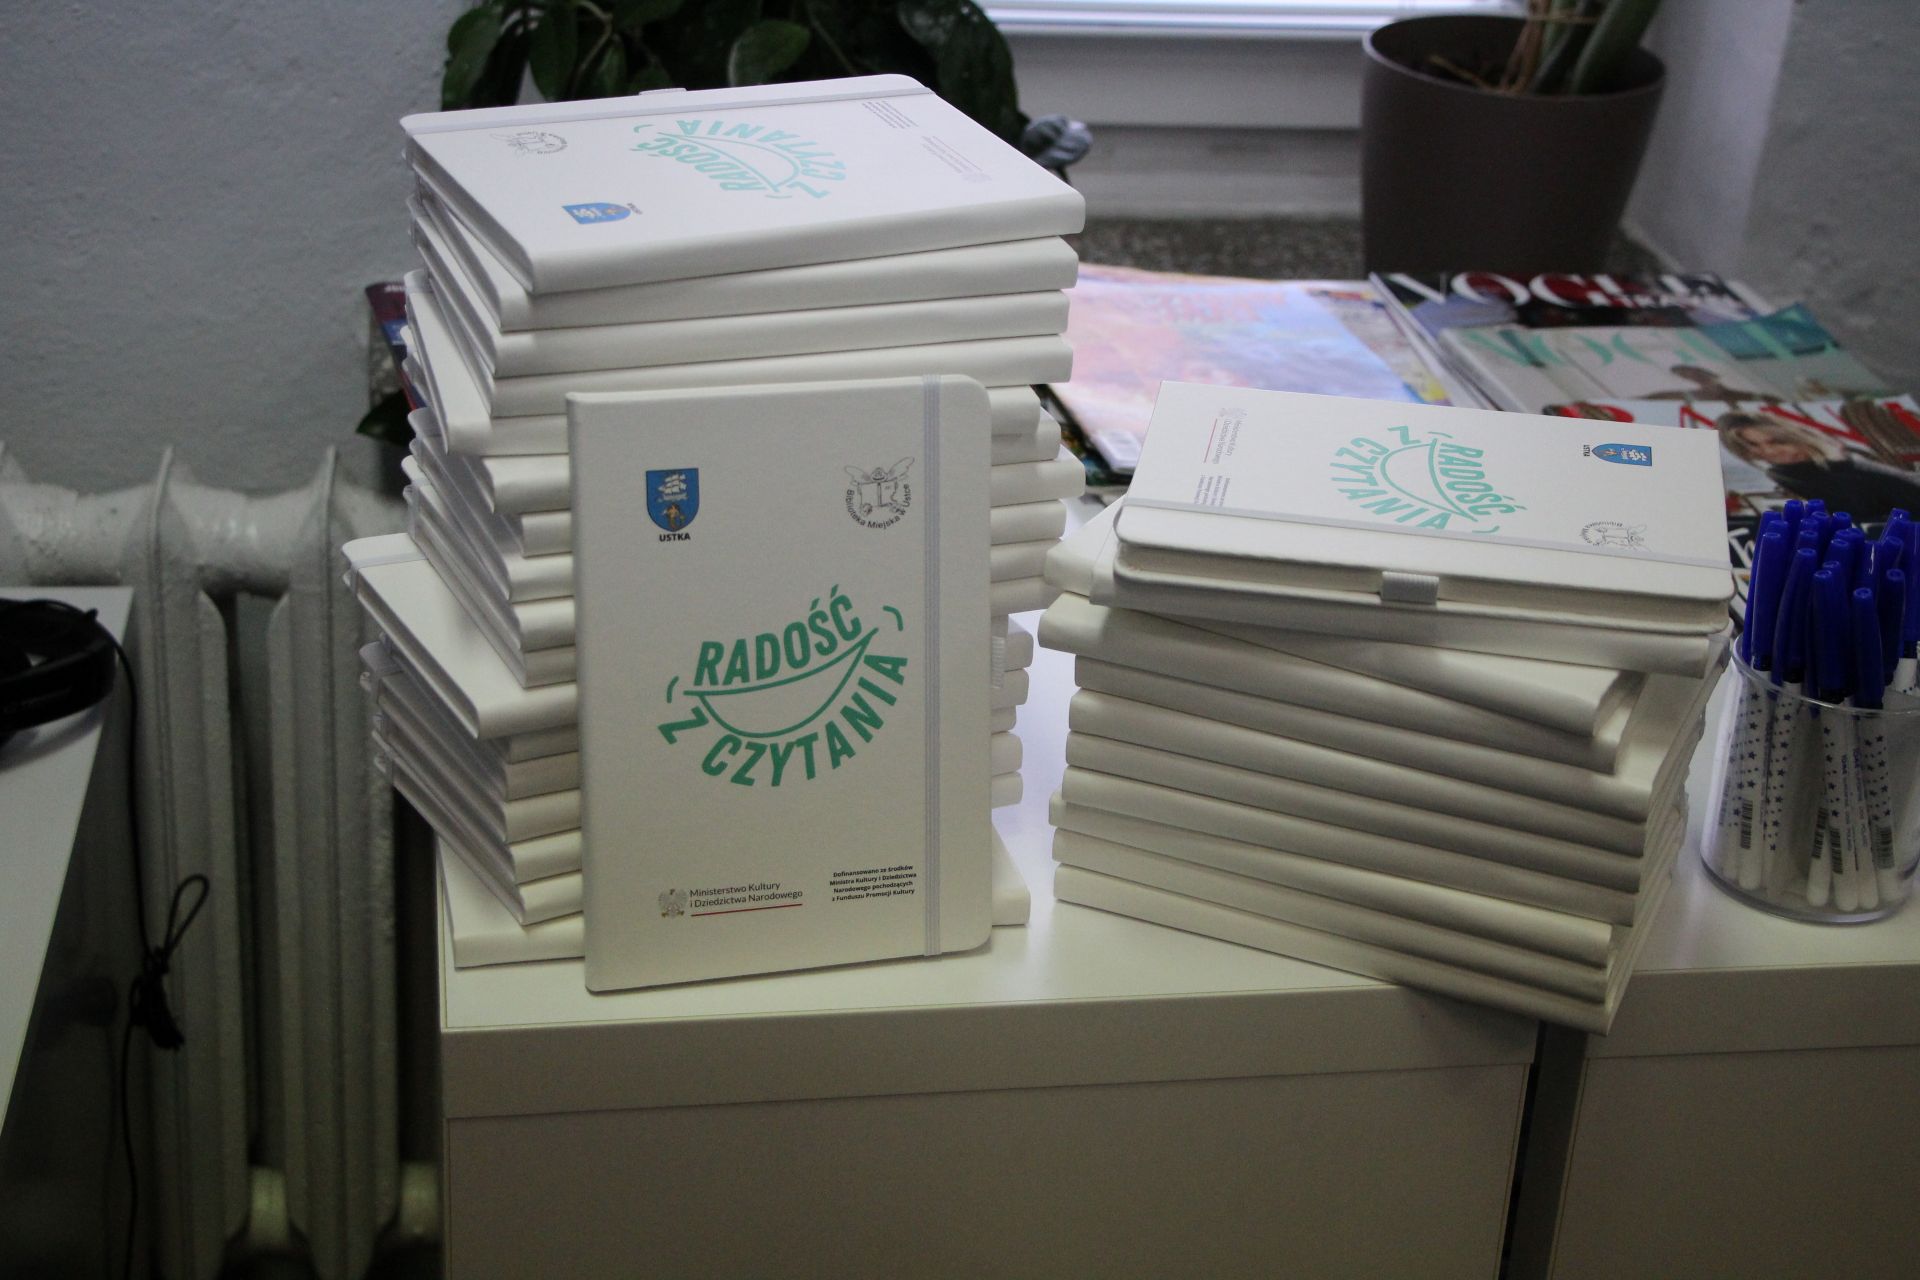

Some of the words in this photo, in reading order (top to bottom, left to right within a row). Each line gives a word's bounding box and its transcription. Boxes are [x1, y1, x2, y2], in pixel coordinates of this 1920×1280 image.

[629, 136, 770, 191] RADOŚĆ
[1329, 436, 1452, 530] CZYTANIA
[1437, 442, 1528, 517] RADOŚĆ
[867, 515, 901, 530] Miejska
[658, 532, 691, 542] USTKA
[693, 583, 862, 687] RADOŚĆ
[657, 706, 709, 745] Z
[702, 654, 908, 788] CZYTANIA
[829, 879, 855, 887] Ministra
[855, 876, 877, 884] Kultury
[833, 869, 879, 878] Dofinansowano
[689, 885, 747, 898] Ministerstwo
[748, 882, 781, 893] Kultury
[833, 885, 871, 893] Narodowego
[836, 893, 865, 901] Funduszu
[892, 888, 915, 896] Kultury
[694, 896, 747, 908] Dziedzictwa
[748, 890, 803, 902] Narodowego
